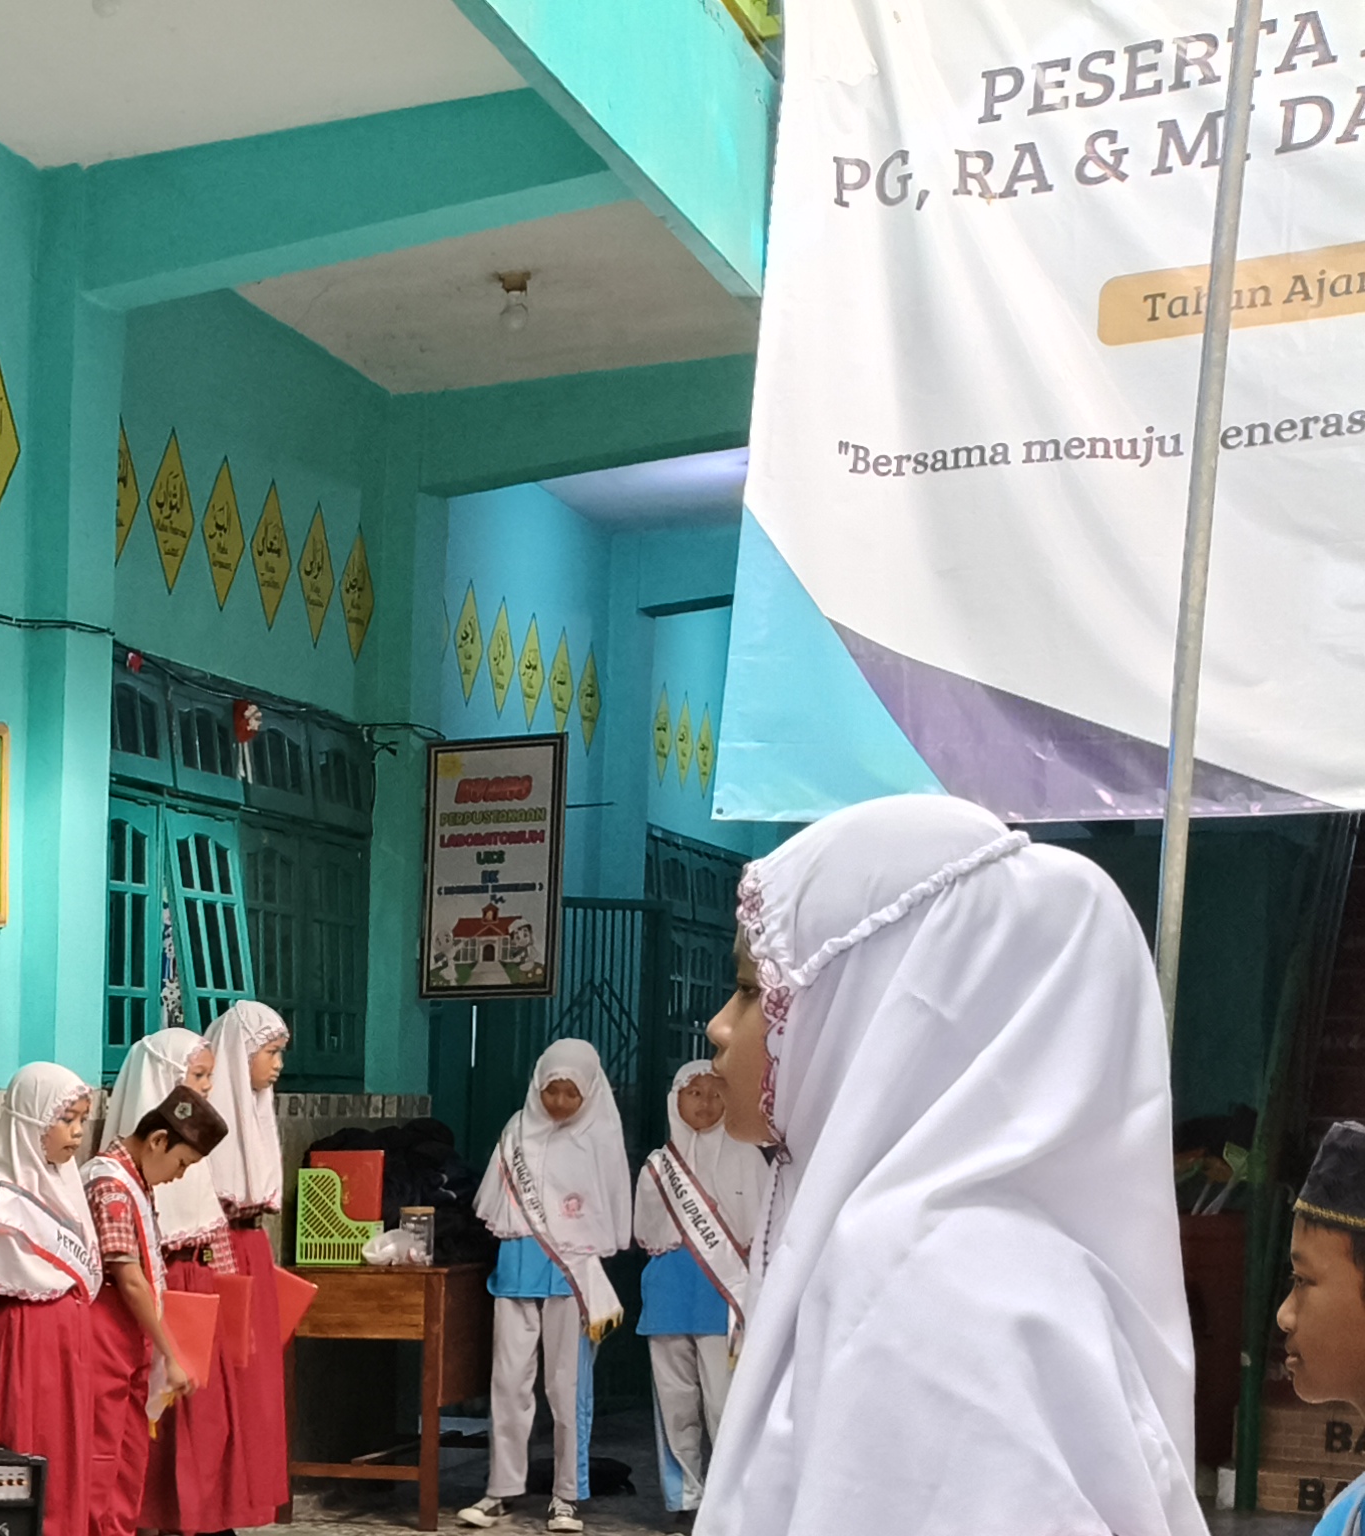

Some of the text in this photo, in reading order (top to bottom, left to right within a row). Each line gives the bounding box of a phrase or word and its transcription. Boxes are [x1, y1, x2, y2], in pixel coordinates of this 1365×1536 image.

[831, 148, 930, 211] PG,
[952, 141, 1054, 202] RA
[1074, 129, 1130, 186] &
[1150, 104, 1256, 176] M
[837, 409, 1365, 477] "Bersama menuju eneras
[439, 807, 547, 827] PERPUSTAKAAN
[439, 829, 546, 849] LABORATORIUM
[681, 1198, 720, 1250] UPACARA
